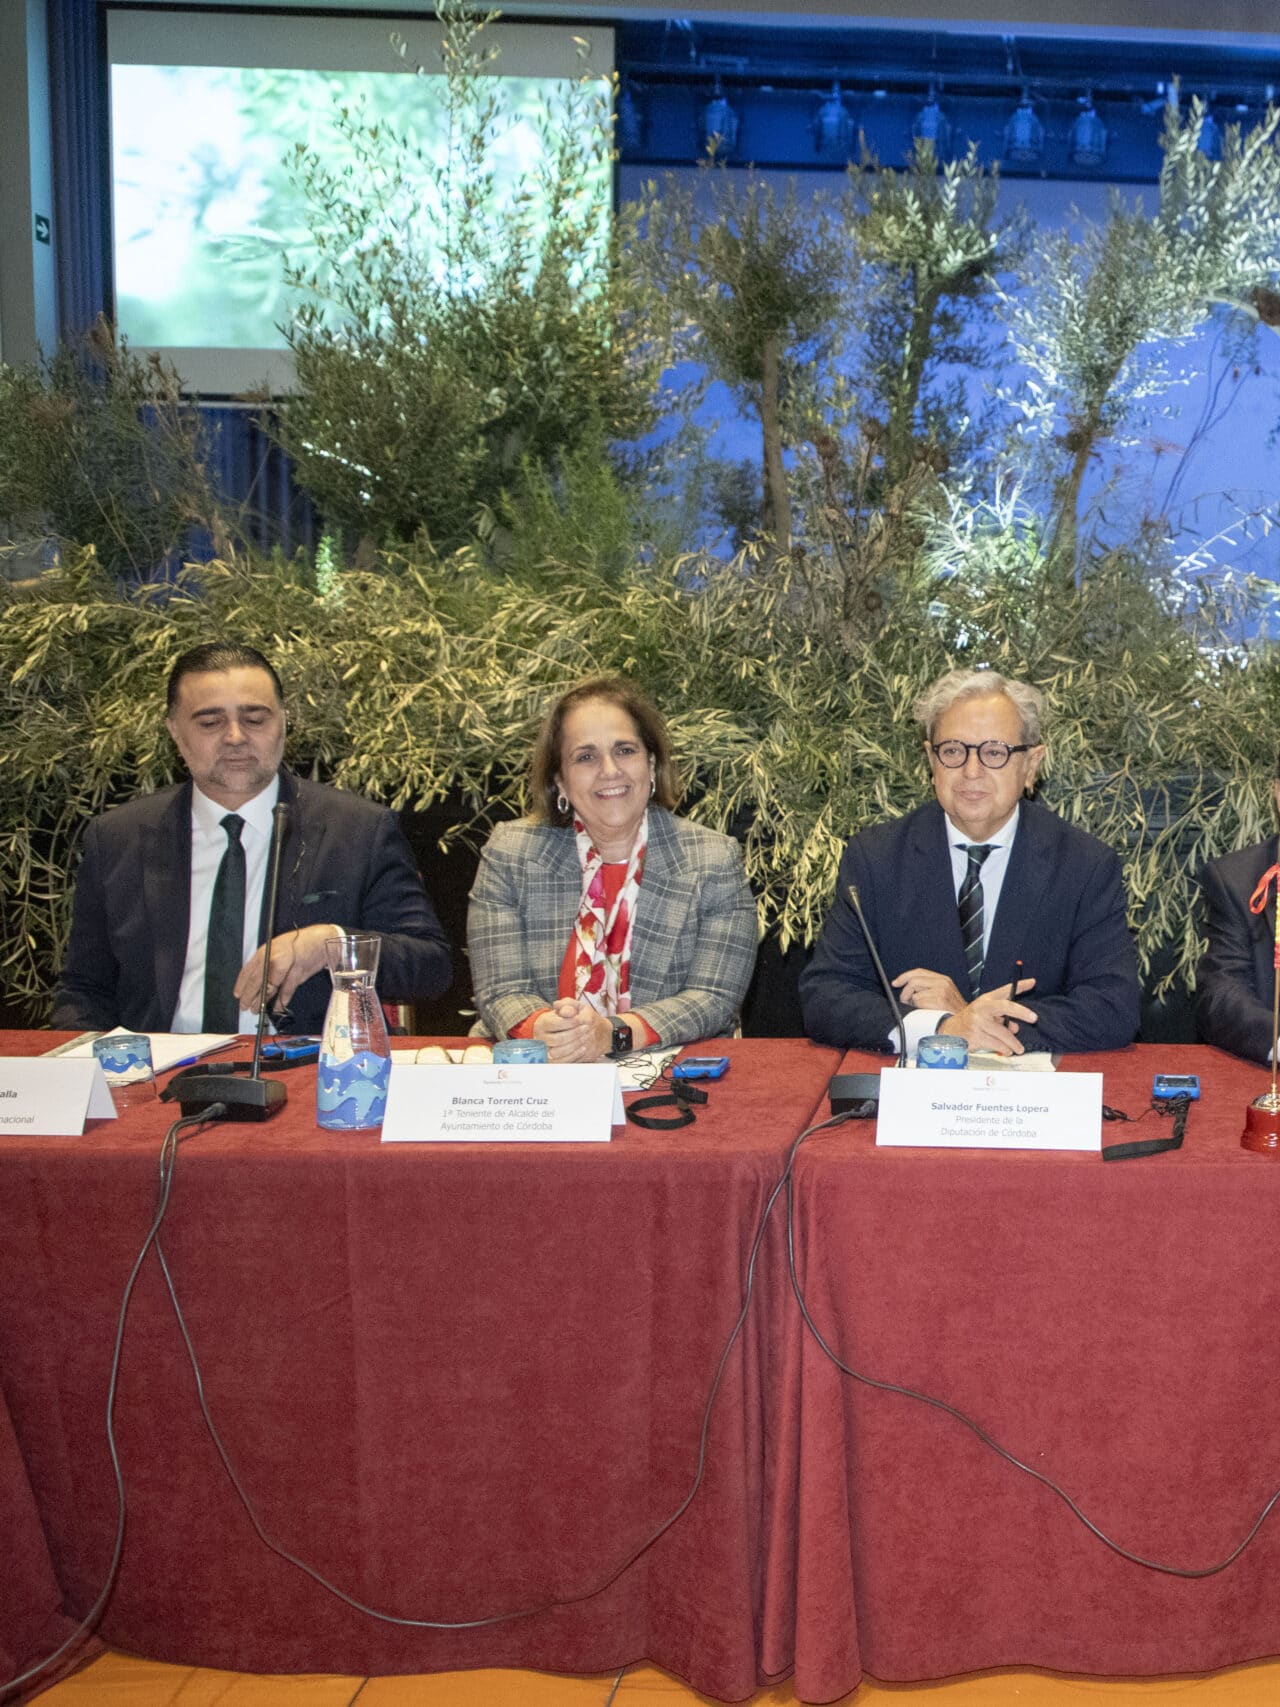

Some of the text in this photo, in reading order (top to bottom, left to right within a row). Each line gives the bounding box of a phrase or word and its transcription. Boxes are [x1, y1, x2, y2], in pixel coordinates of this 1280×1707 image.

[451, 1096, 549, 1105] Blanca Torrent Cruz
[931, 1102, 1049, 1114] Salvador Fuentes Lopera
[456, 1109, 492, 1118] Teniente
[494, 1109, 506, 1118] de
[508, 1109, 539, 1118] Alcalde
[956, 1115, 1024, 1125] Presidente de la
[441, 1121, 553, 1132] Ayuntamiento de Córdoba
[940, 1127, 986, 1138] Diputación
[988, 1128, 999, 1137] de
